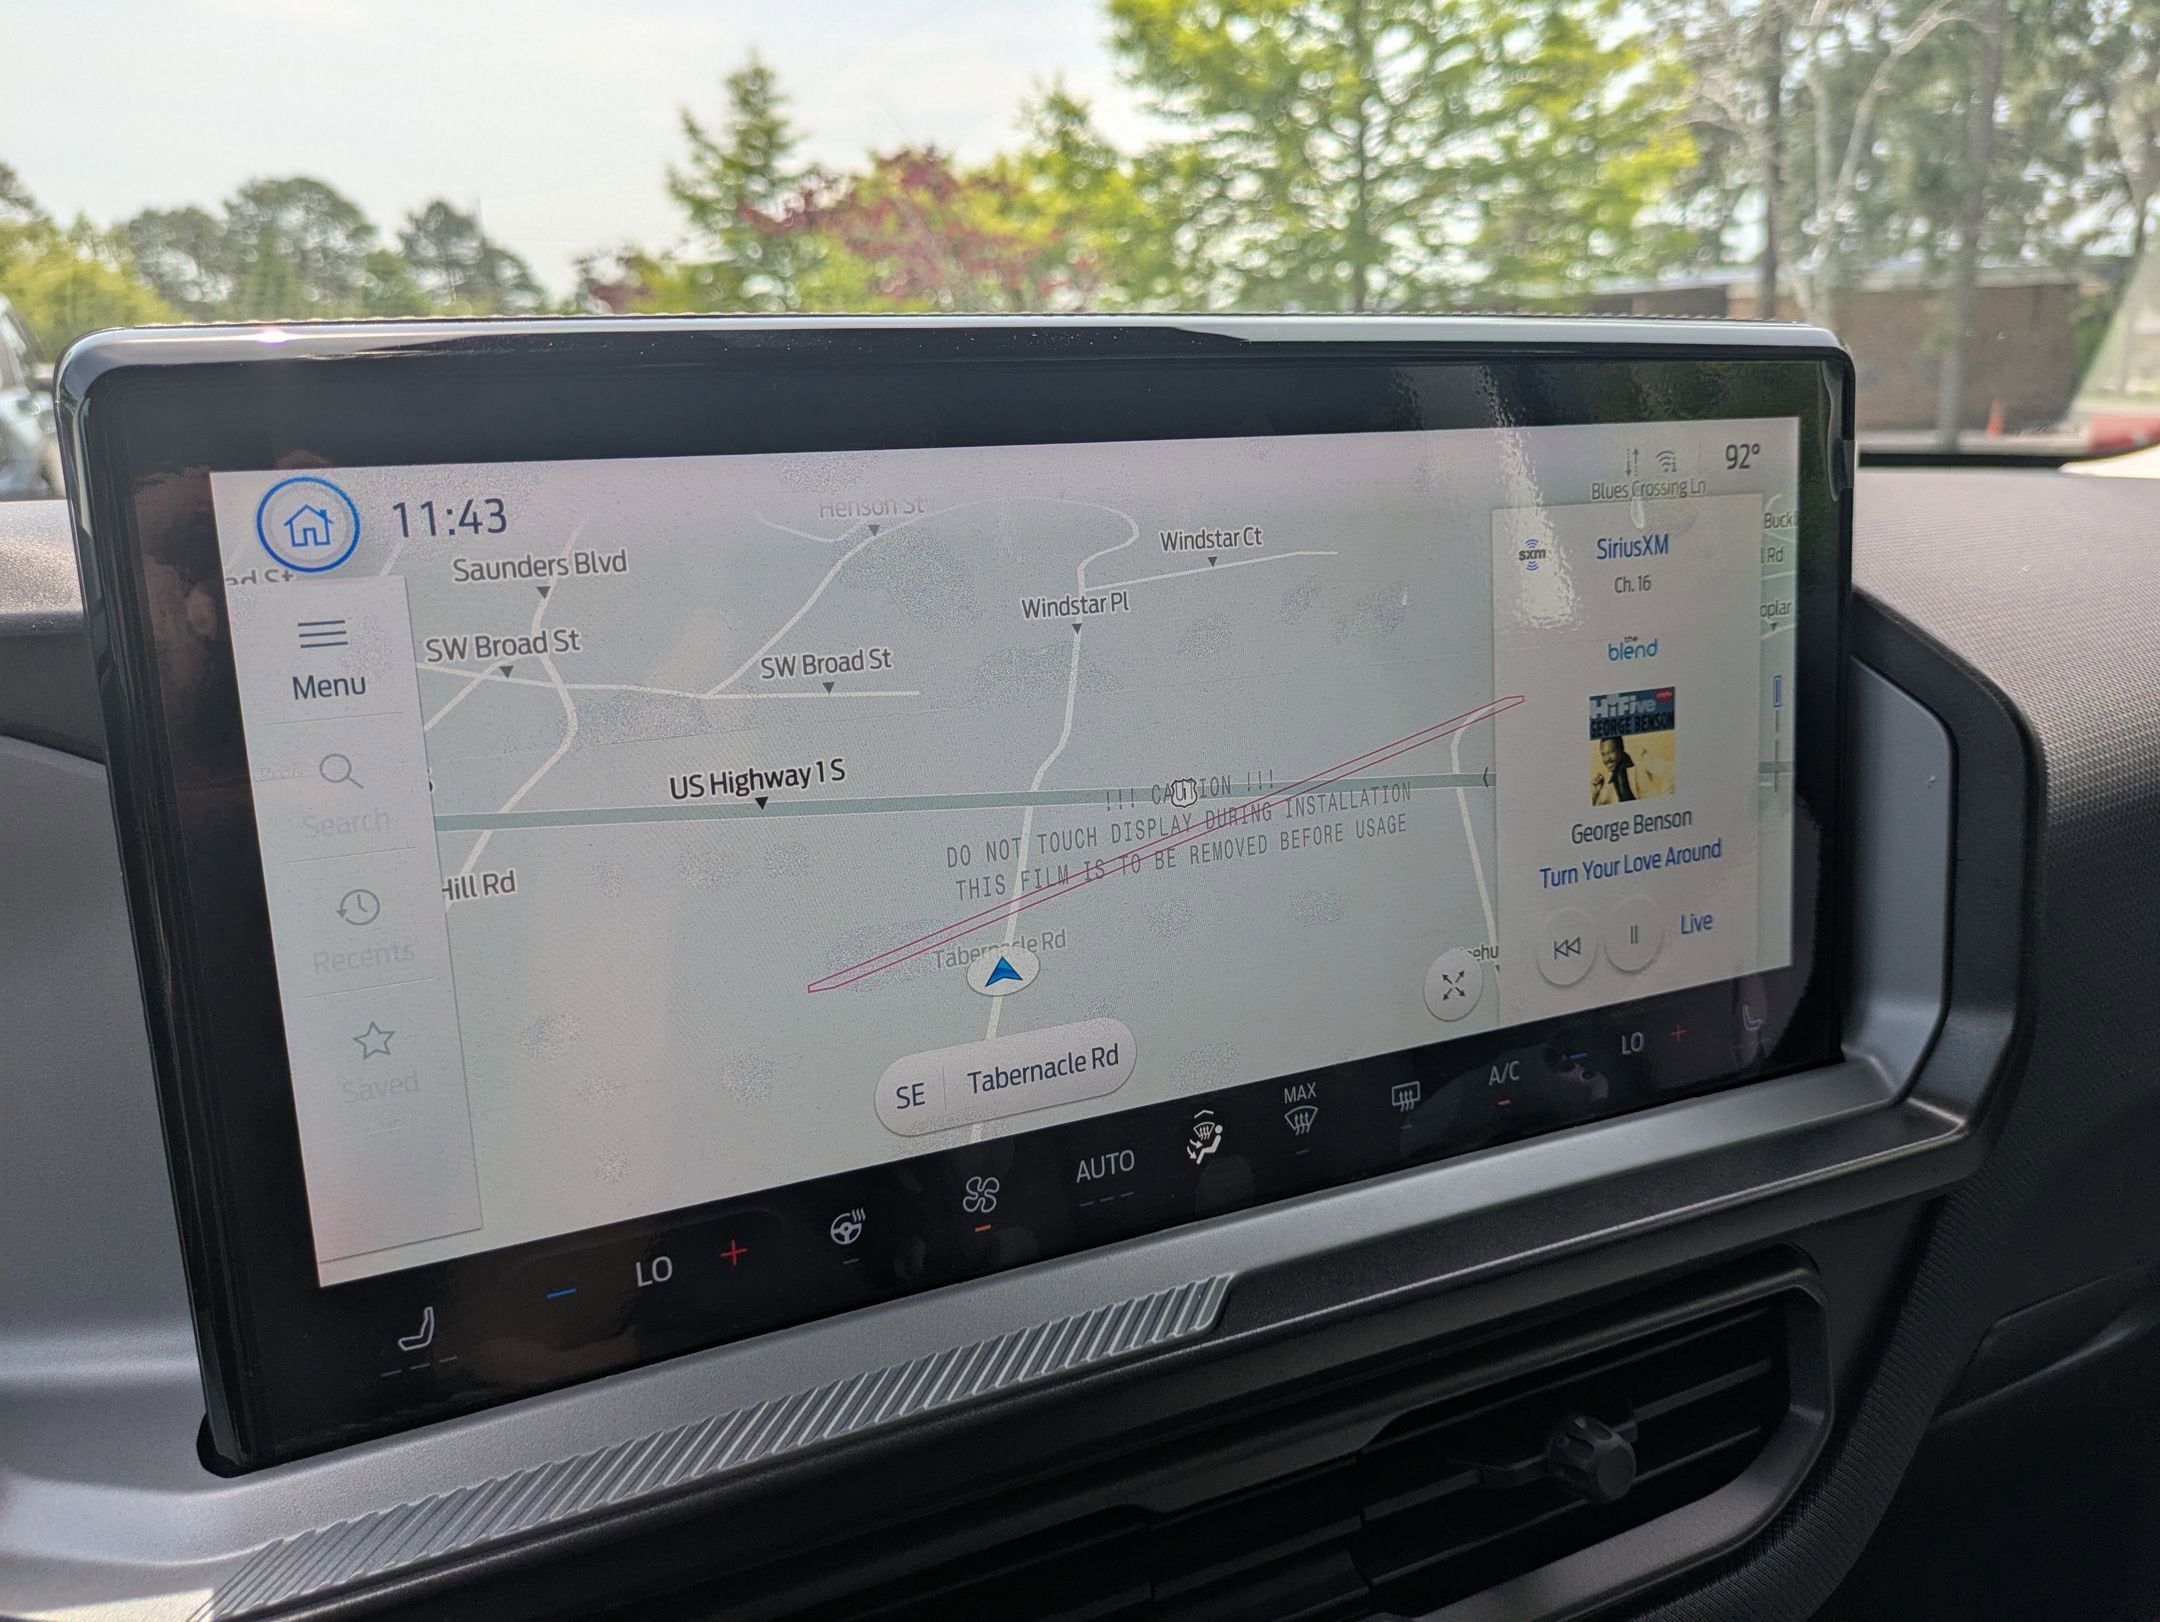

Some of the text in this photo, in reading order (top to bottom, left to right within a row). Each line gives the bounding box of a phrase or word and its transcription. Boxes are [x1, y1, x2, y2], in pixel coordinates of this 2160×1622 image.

[1592, 478, 1706, 500] Blues Crossing Ln
[392, 498, 507, 538] 11:43
[1161, 526, 1263, 552] Windstar Ct
[1597, 534, 1669, 560] SiriusXM
[453, 549, 628, 583] Saunders Blvd
[1518, 549, 1547, 561] sxm
[1768, 547, 1784, 562] Rd
[1614, 575, 1652, 594] Ch. 16
[1021, 591, 1129, 619] Windstar Pl
[425, 629, 581, 662] SW Broad St
[1608, 639, 1658, 661] blend
[1624, 635, 1639, 644] the
[760, 647, 892, 679] SW Broad St
[292, 674, 366, 700] Menu
[670, 758, 846, 800] US Highway 1 S
[1151, 774, 1232, 805] CAUTION
[302, 808, 391, 840] Search
[947, 781, 1411, 868] DO NOT TOUCH DISPLAY DURING INSTALLATION
[1572, 809, 1692, 844] George Benson
[956, 813, 1407, 900] THIS FILM IS TO BE REMOVED BEFORE USAGE
[1540, 838, 1722, 889] Turn Your Love Around
[483, 870, 516, 896] Rd
[1681, 911, 1713, 935] Live
[1042, 929, 1067, 951] Rd
[313, 941, 416, 975] Recents
[1621, 1032, 1644, 1055] LO
[341, 1072, 420, 1102] Saved
[896, 1042, 1120, 1111] SE Tabernacle Rd
[1488, 1060, 1520, 1086] A/C
[1284, 1081, 1318, 1103] MAX
[1076, 1150, 1136, 1183] AUTO
[635, 1255, 673, 1288] LO
